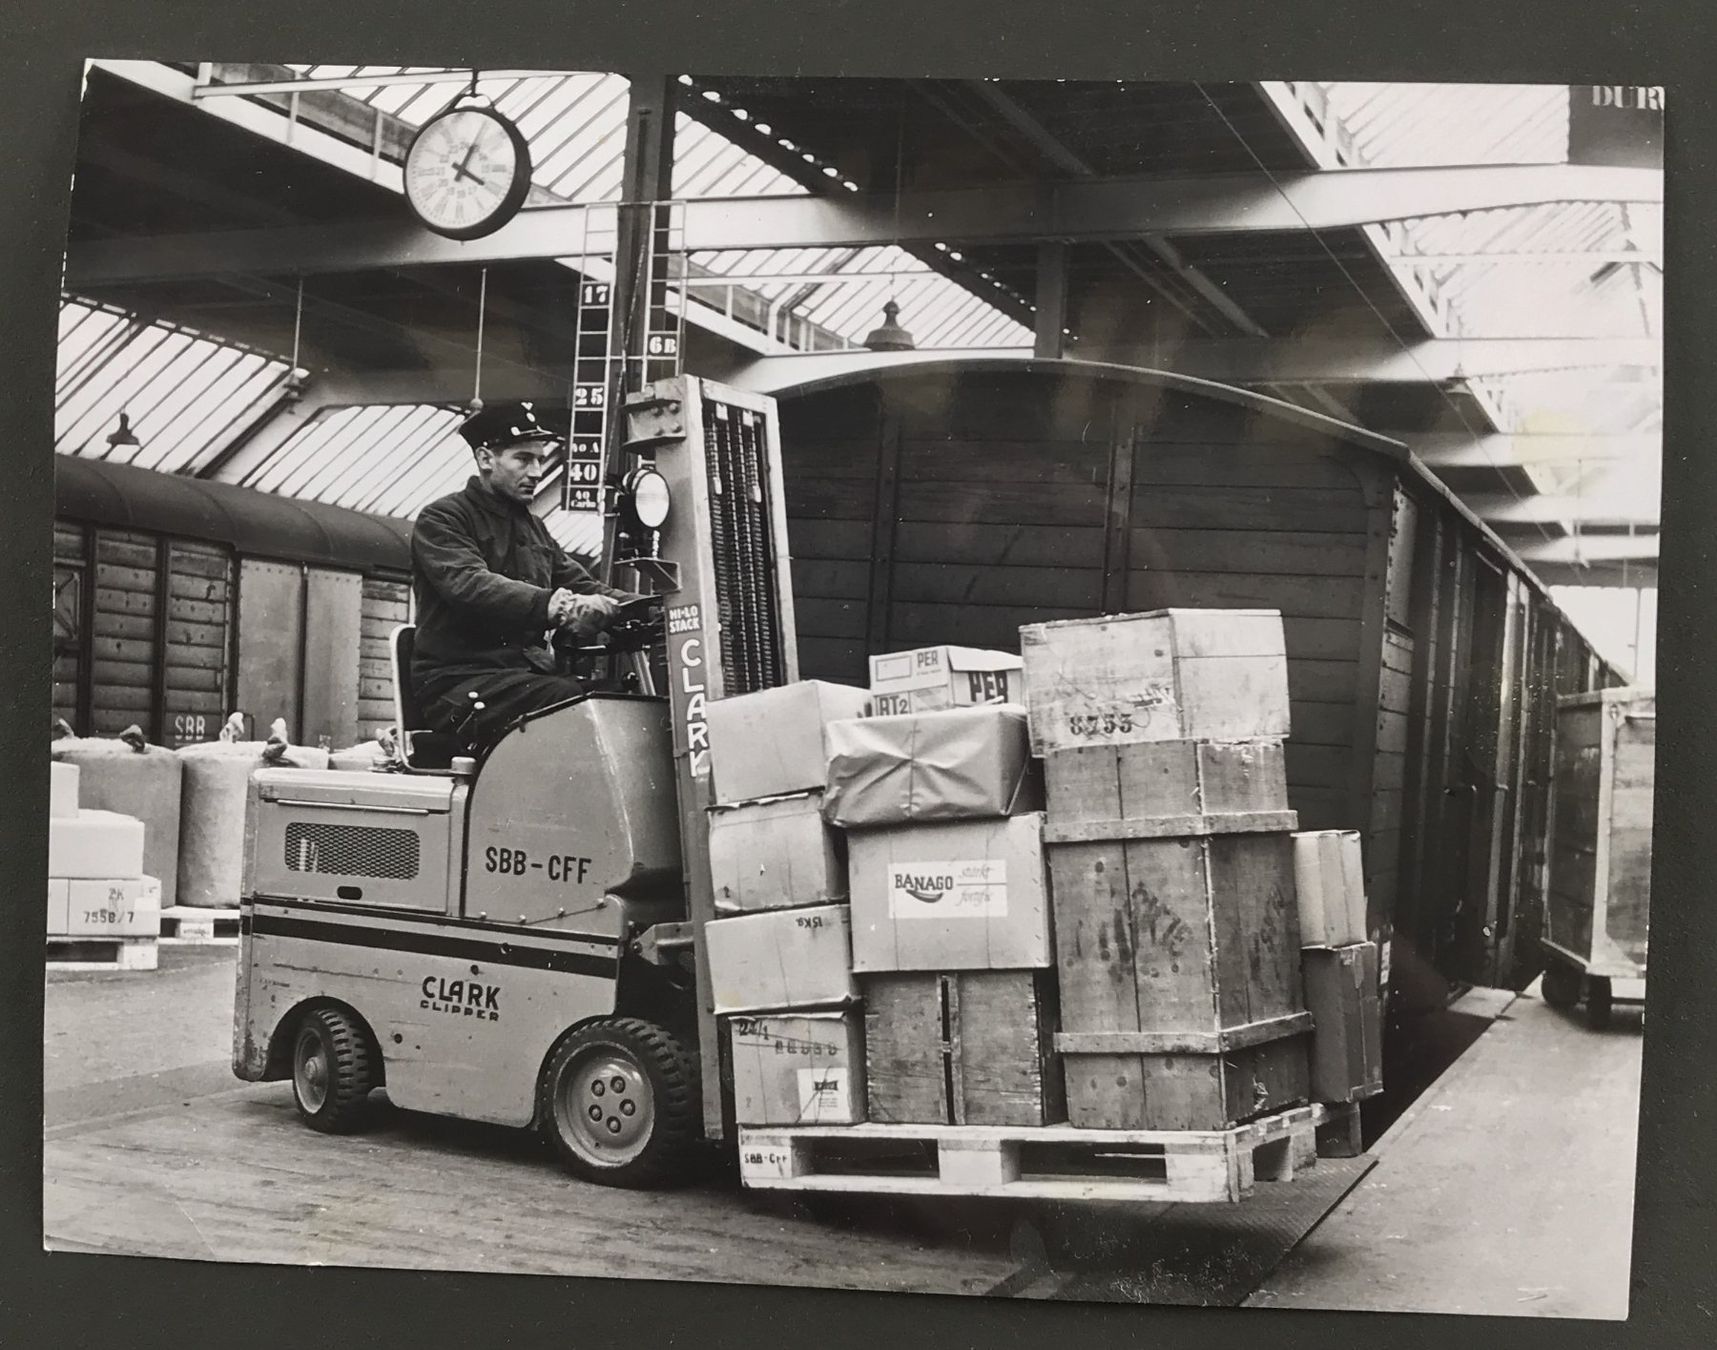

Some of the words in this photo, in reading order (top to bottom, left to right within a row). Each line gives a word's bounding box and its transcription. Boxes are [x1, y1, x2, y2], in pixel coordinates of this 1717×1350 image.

[584, 285, 608, 303] 17
[649, 336, 677, 354] 6B
[574, 387, 604, 406] 25
[570, 463, 598, 482] 40
[669, 605, 698, 620] HI-LO
[669, 618, 700, 633] STACK
[917, 650, 938, 668] PER
[967, 670, 1009, 704] PER
[680, 638, 711, 778] CLARK
[174, 715, 206, 740] SBB
[894, 873, 954, 891] BANAGO
[422, 975, 501, 1011] CLARK
[420, 1000, 500, 1022] CLIPPER
